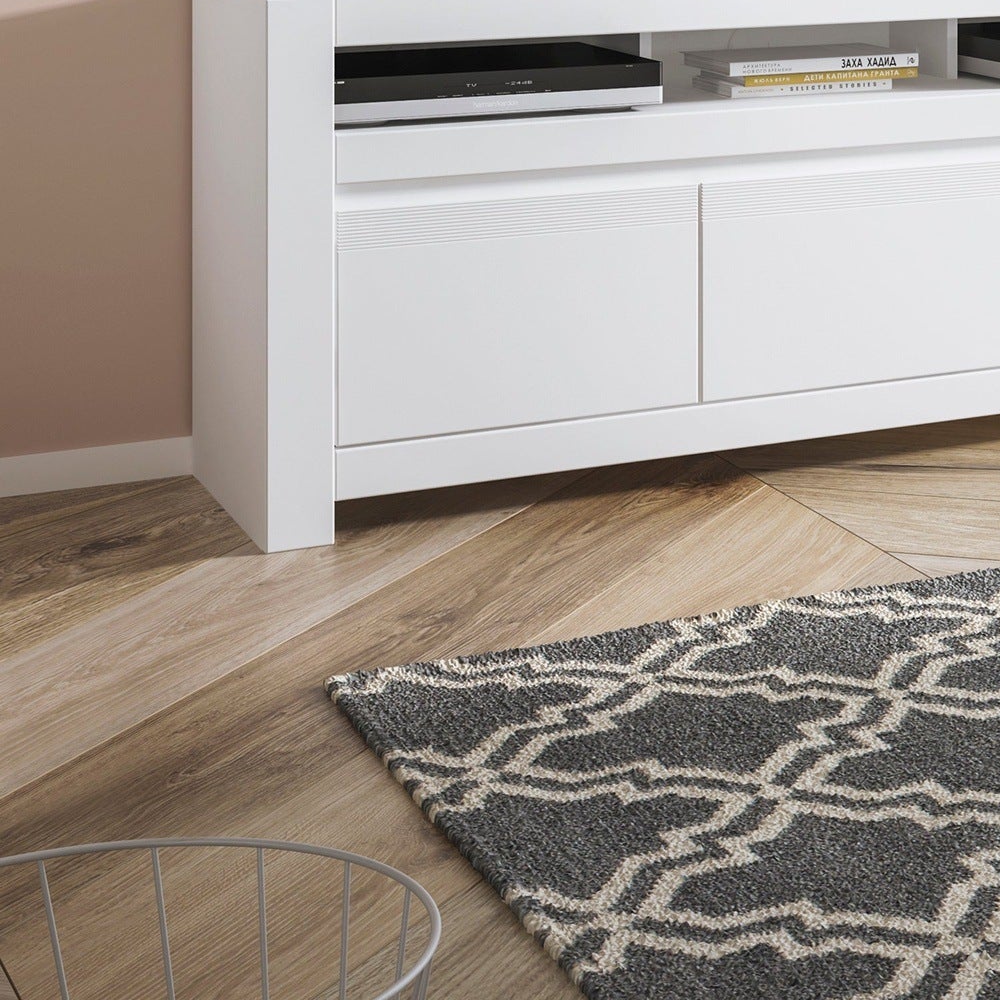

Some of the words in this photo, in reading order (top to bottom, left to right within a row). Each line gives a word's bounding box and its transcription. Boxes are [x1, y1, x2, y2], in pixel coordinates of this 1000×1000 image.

[841, 58, 863, 69] ЗАХА
[866, 56, 897, 67] ХАДИД
[803, 74, 824, 82] ДЕТИ
[826, 70, 869, 80] КАПИТАНА
[870, 69, 900, 78] ГРАНТА
[790, 84, 833, 92] SELECTED
[839, 81, 877, 89] STORIES
